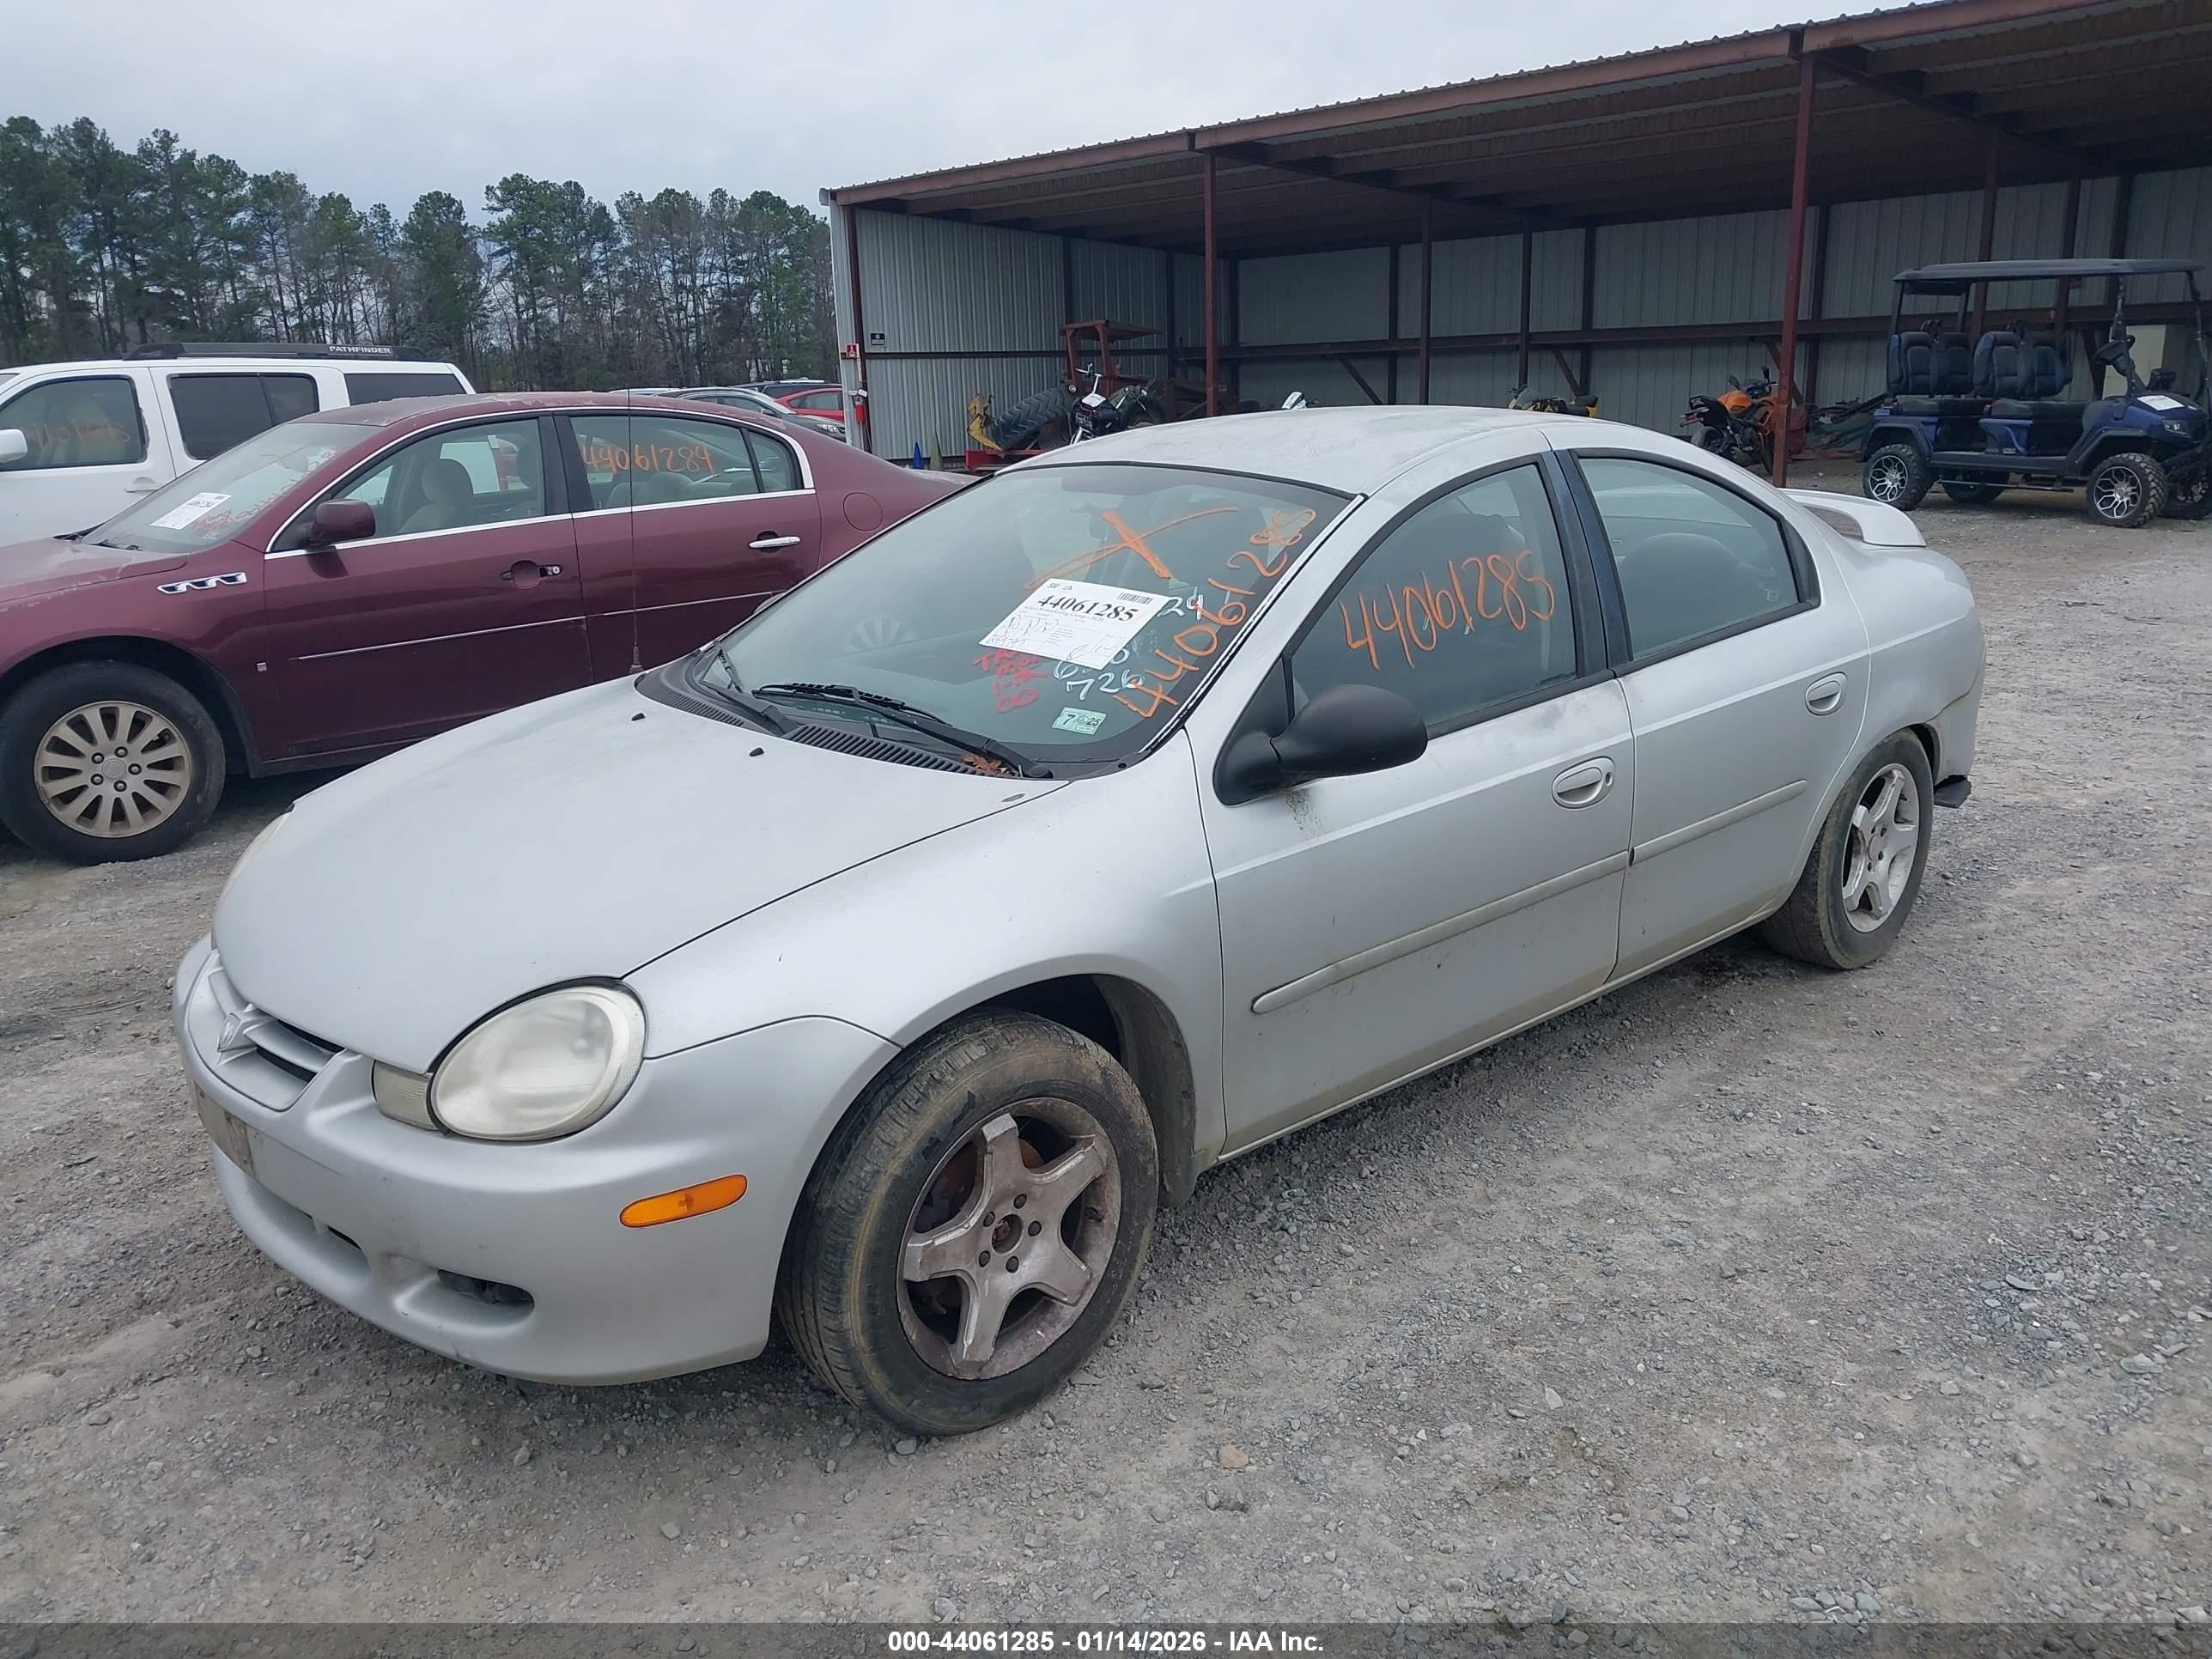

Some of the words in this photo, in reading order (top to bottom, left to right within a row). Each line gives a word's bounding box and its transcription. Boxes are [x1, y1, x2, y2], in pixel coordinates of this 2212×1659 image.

[582, 444, 714, 476] 44061284
[1037, 594, 1139, 622] 44061285
[1339, 550, 1555, 672] 44061285
[1063, 714, 1076, 726] 7
[1086, 717, 1102, 726] 25
